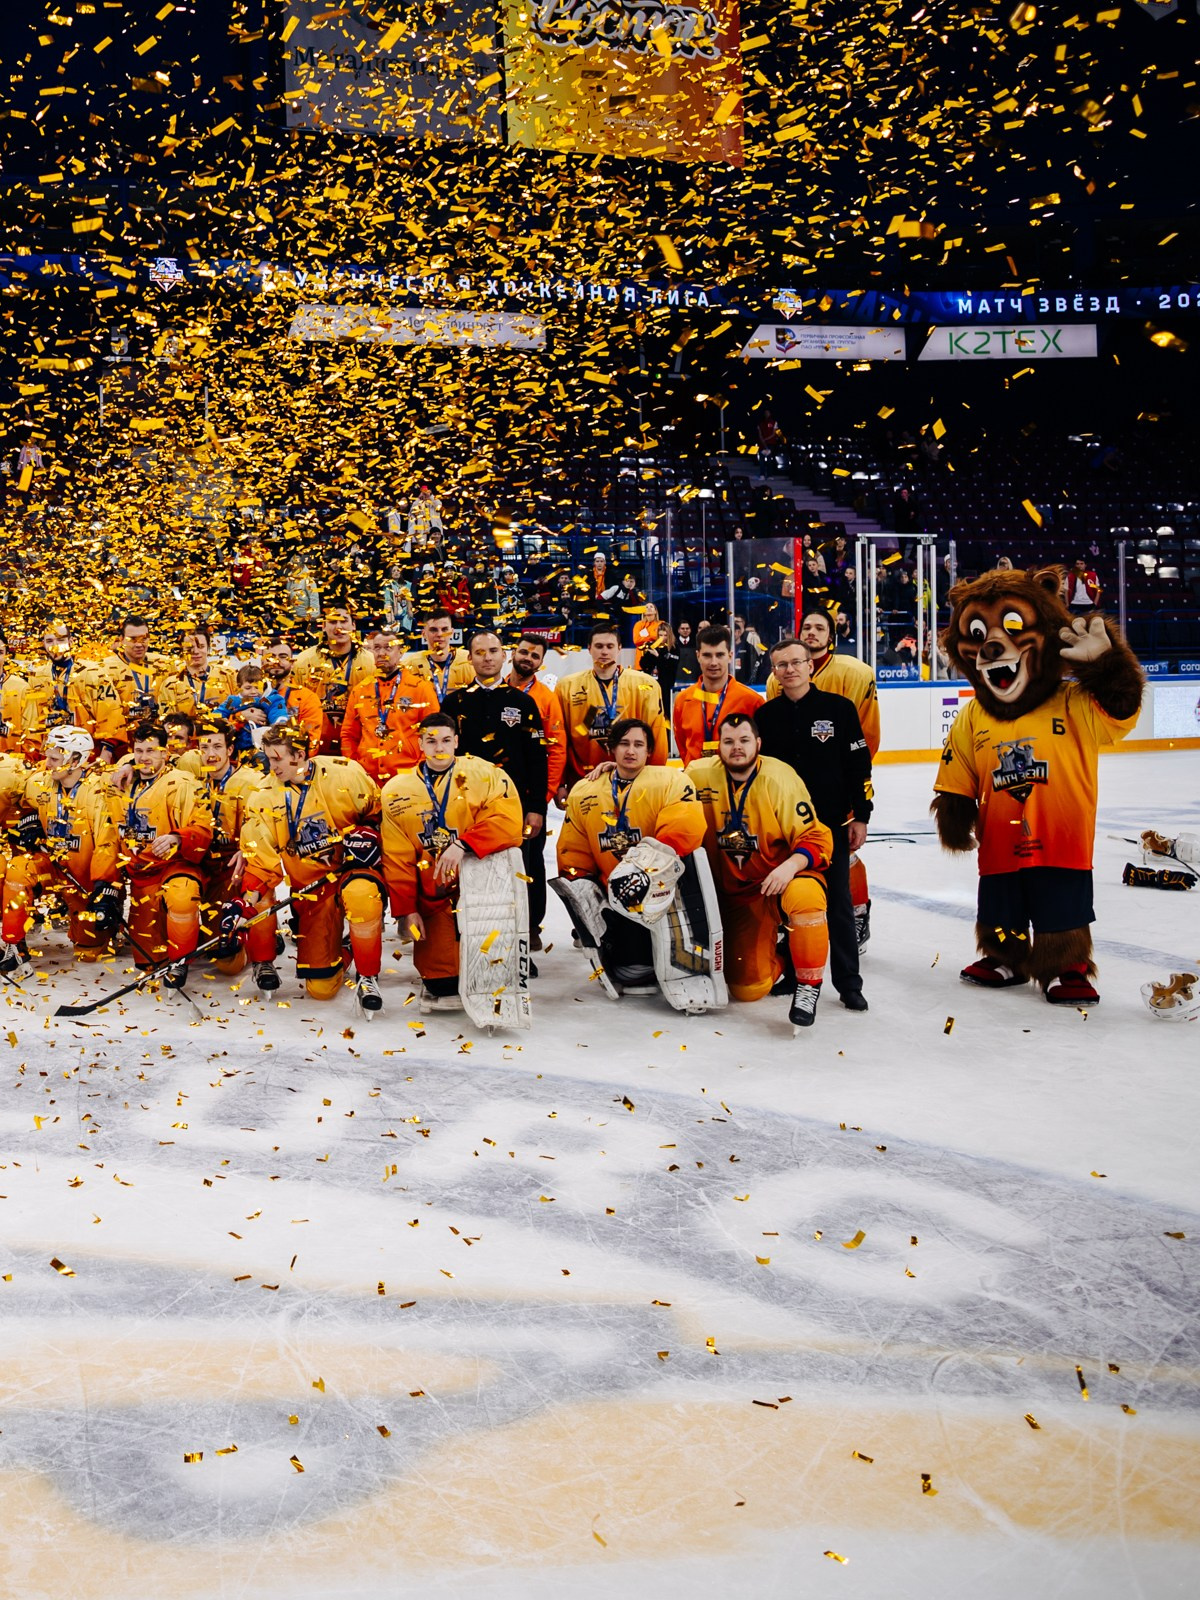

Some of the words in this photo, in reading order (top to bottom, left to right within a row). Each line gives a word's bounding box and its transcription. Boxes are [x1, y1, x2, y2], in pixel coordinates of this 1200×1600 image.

[651, 288, 709, 307] ЛИГА
[958, 298, 1023, 314] МАТЧ
[1039, 293, 1120, 314] ЗВЁЗД
[948, 329, 1063, 355] K2TEX
[523, 630, 561, 640] NBET
[97, 685, 116, 700] 24
[1052, 717, 1066, 736] Б
[994, 773, 1017, 787] МАТЧ
[796, 801, 814, 825] 9
[343, 839, 372, 848] UER
[519, 939, 528, 989] CCM
[714, 939, 722, 971] VAUGHN
